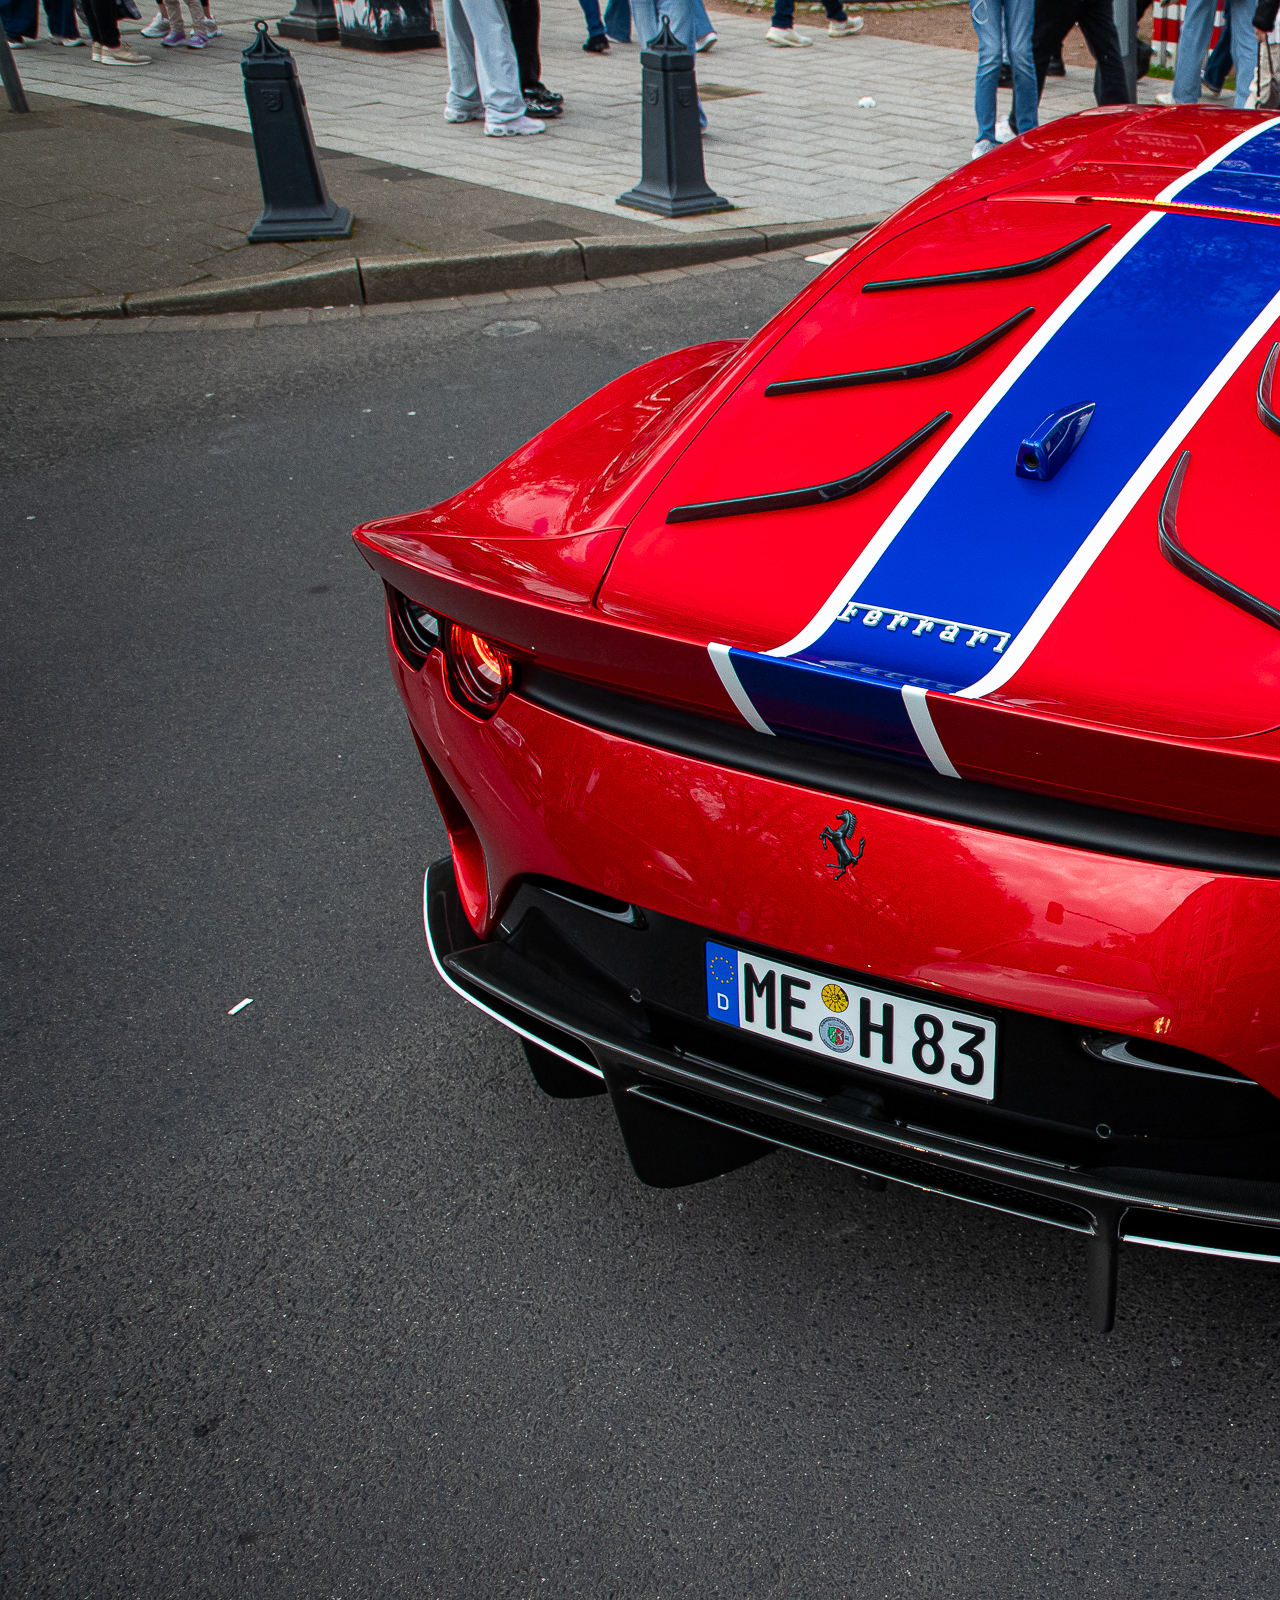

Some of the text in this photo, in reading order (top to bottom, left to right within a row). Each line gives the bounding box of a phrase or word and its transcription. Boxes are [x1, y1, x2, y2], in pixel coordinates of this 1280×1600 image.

[837, 601, 1012, 653] Ferrari
[717, 993, 729, 1011] D
[743, 962, 813, 1041] ME
[859, 996, 894, 1064] H
[911, 1013, 986, 1086] 83
